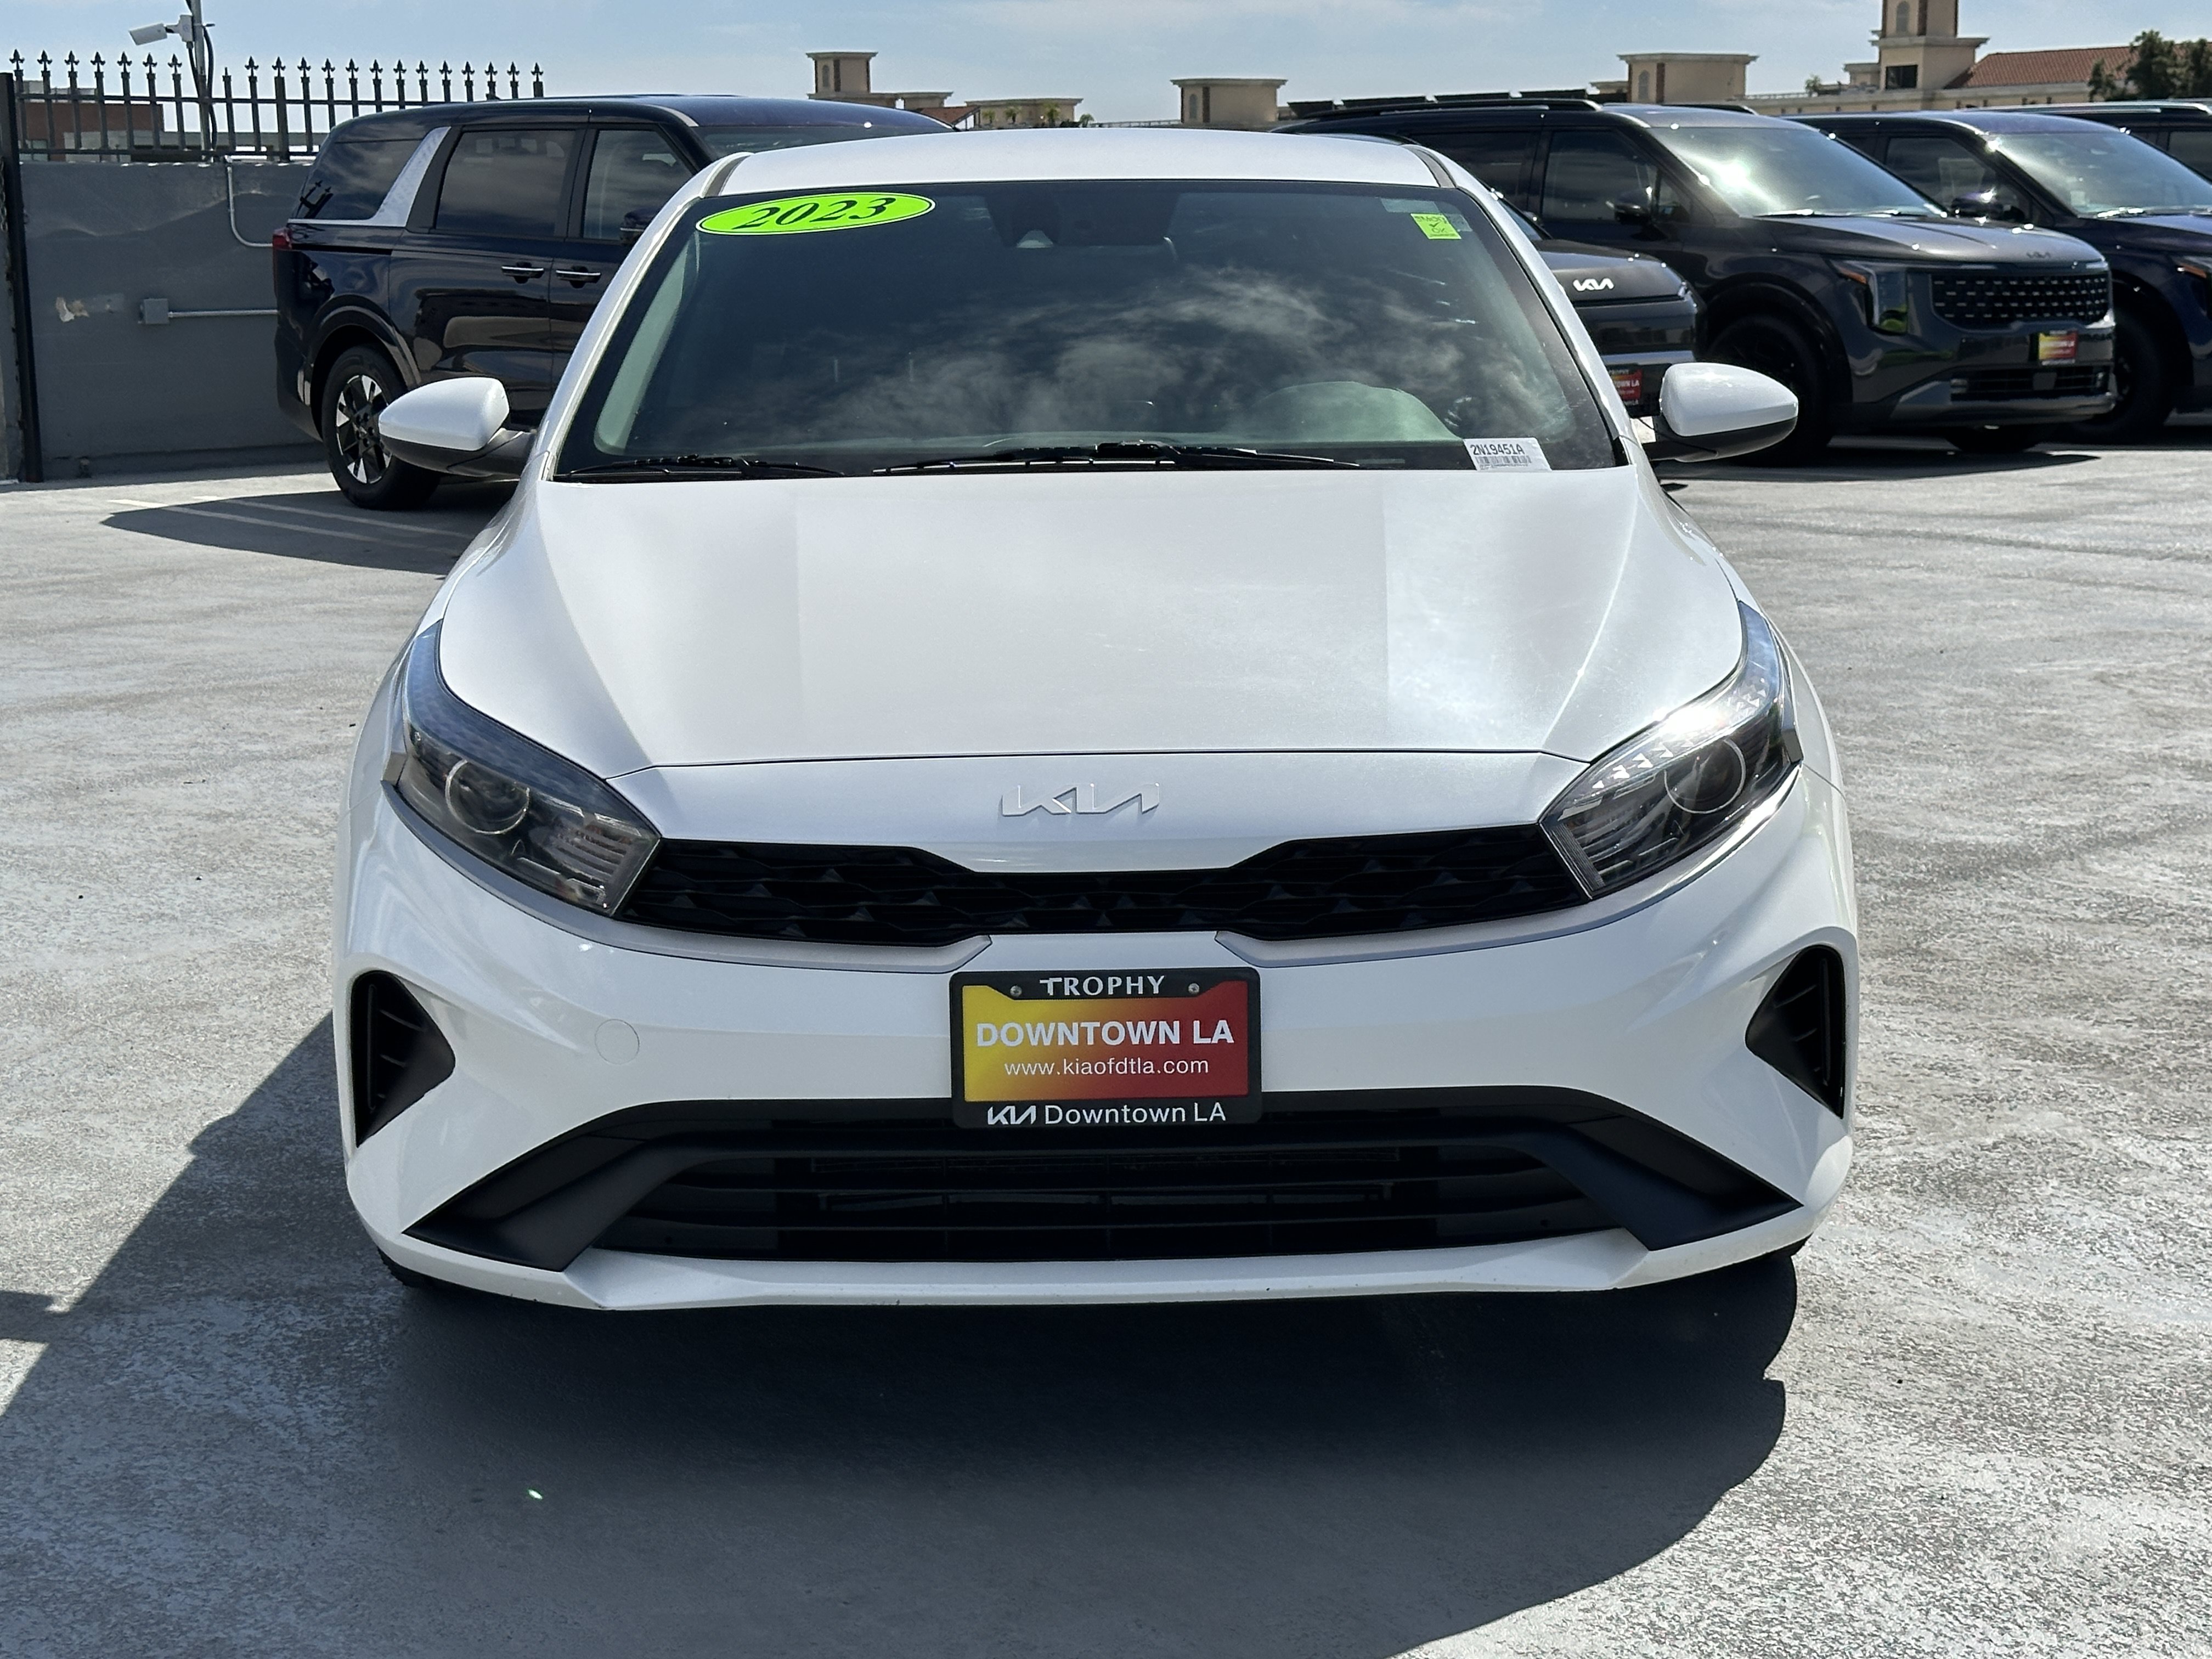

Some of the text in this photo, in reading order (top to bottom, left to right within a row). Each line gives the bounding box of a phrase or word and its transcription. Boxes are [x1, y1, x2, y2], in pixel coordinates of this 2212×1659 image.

[732, 198, 896, 229] 2023
[1470, 443, 1525, 455] 2N19451A
[1000, 782, 1159, 817] KIA
[1040, 975, 1165, 996] TROPHY
[977, 1019, 1234, 1047] DOWNTOWN LA
[1005, 1057, 1209, 1075] www.kiaofdtla.com
[987, 1102, 1227, 1125] KIA Downtown LA
